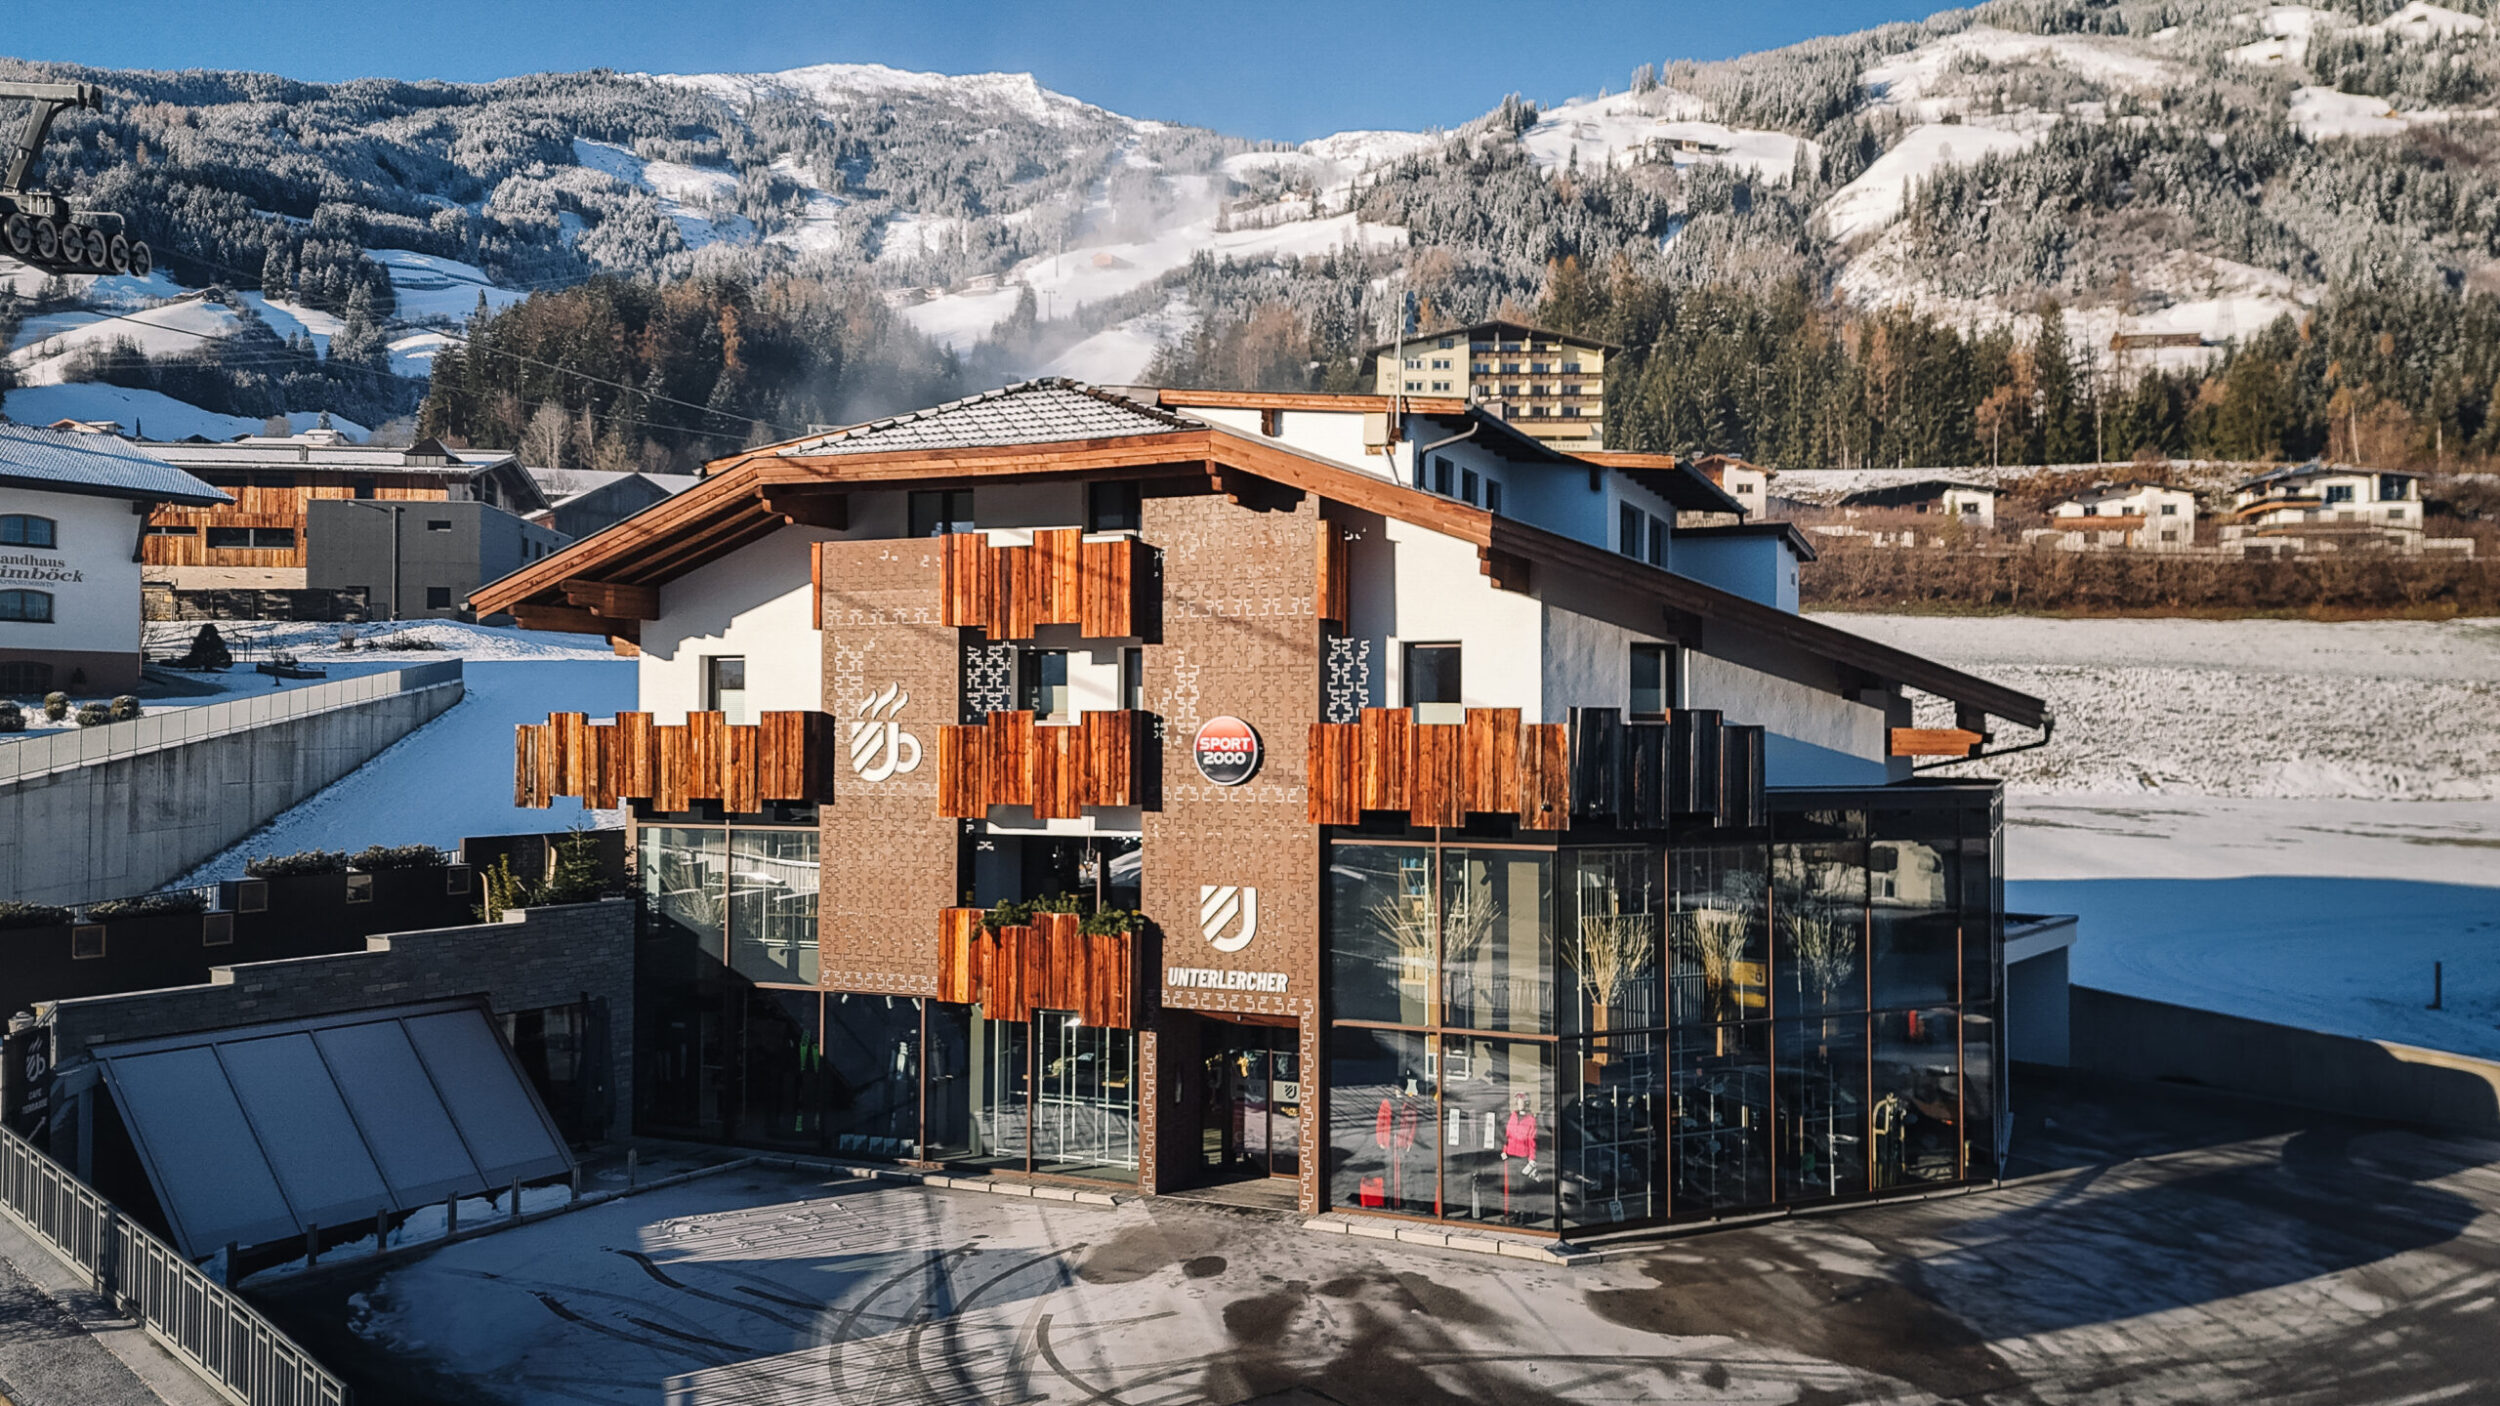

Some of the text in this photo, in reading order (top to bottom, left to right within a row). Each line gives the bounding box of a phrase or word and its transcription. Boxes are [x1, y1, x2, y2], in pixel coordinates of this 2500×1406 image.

[0, 554, 65, 568] andhaus
[0, 565, 84, 582] imböck
[1200, 737, 1251, 751] SPORT
[1203, 751, 1246, 765] 2000
[1167, 967, 1289, 993] UNTERLERCHER
